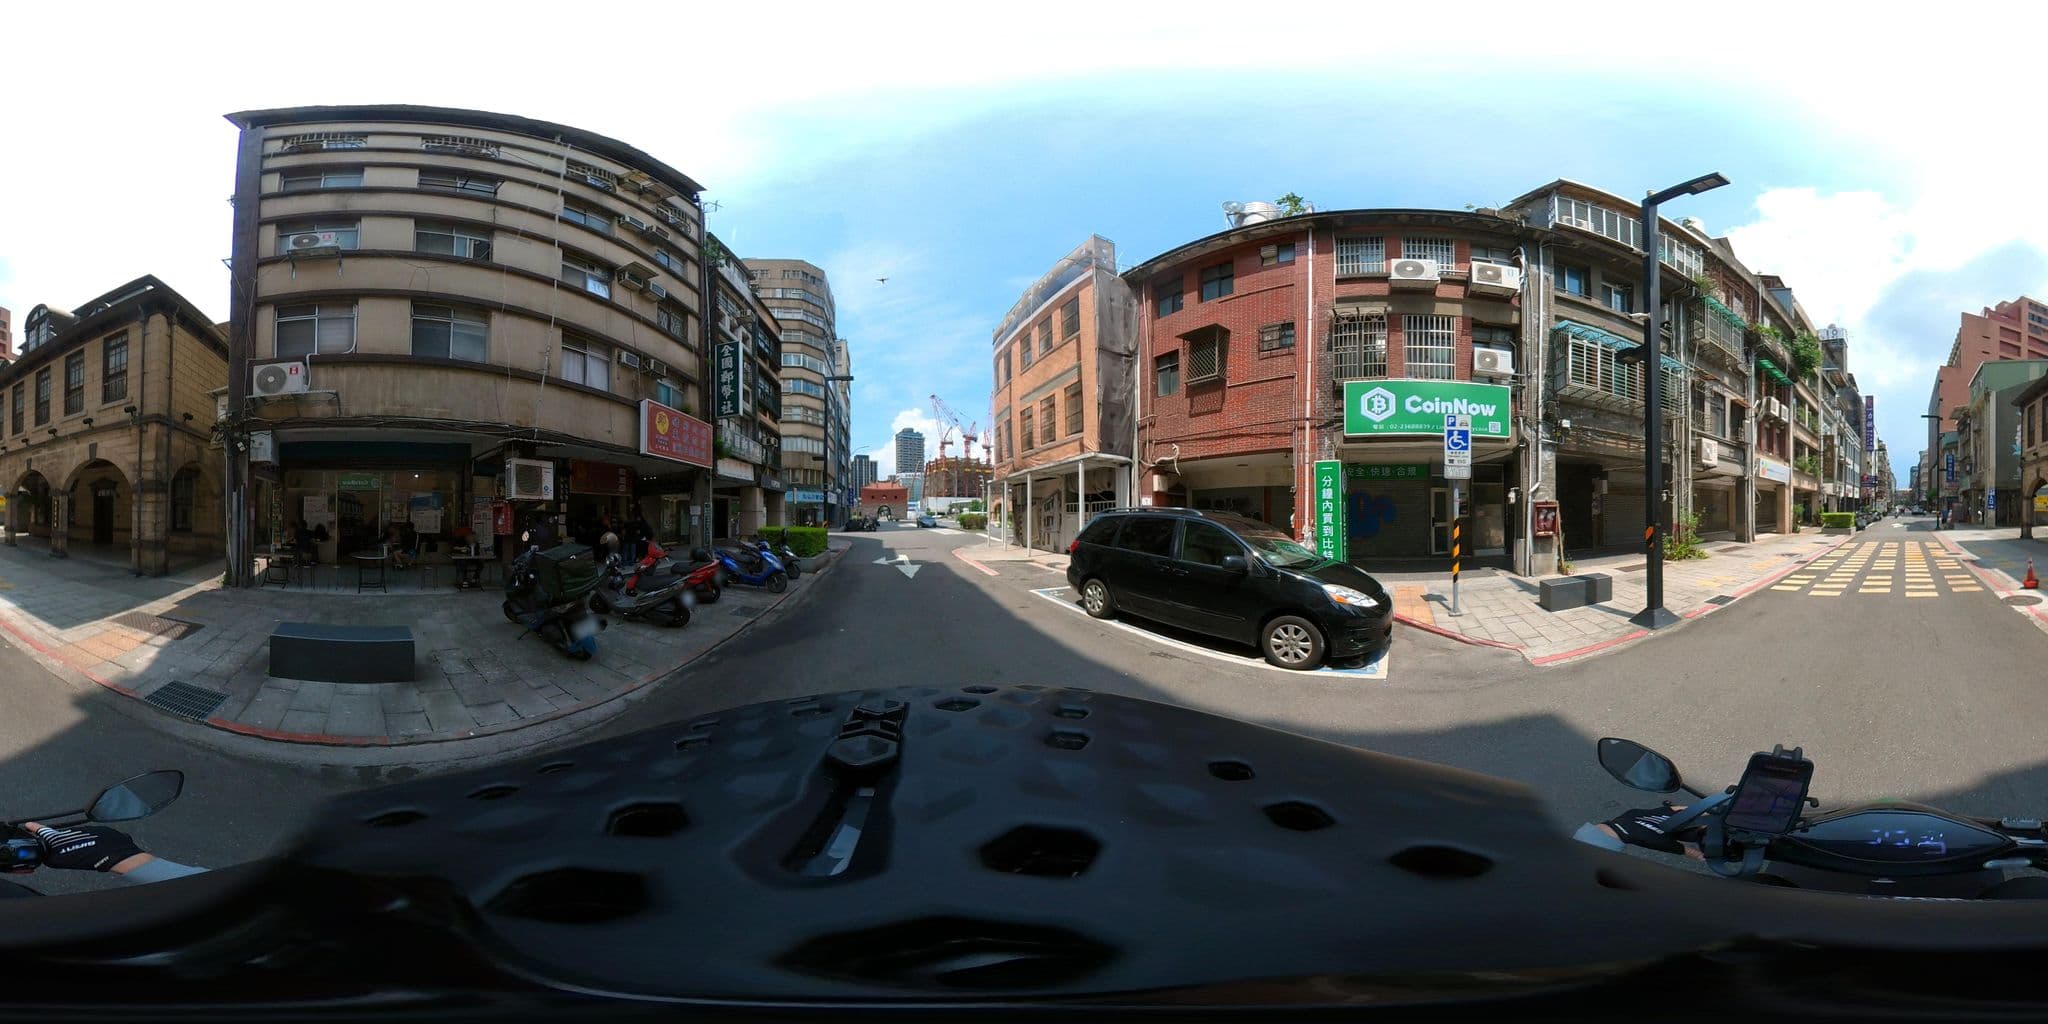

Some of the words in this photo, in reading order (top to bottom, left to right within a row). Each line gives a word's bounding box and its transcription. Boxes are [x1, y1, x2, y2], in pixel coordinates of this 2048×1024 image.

[721, 345, 734, 414] 全國郵幣社
[1405, 394, 1496, 416] CoinNow
[1448, 416, 1455, 426] P
